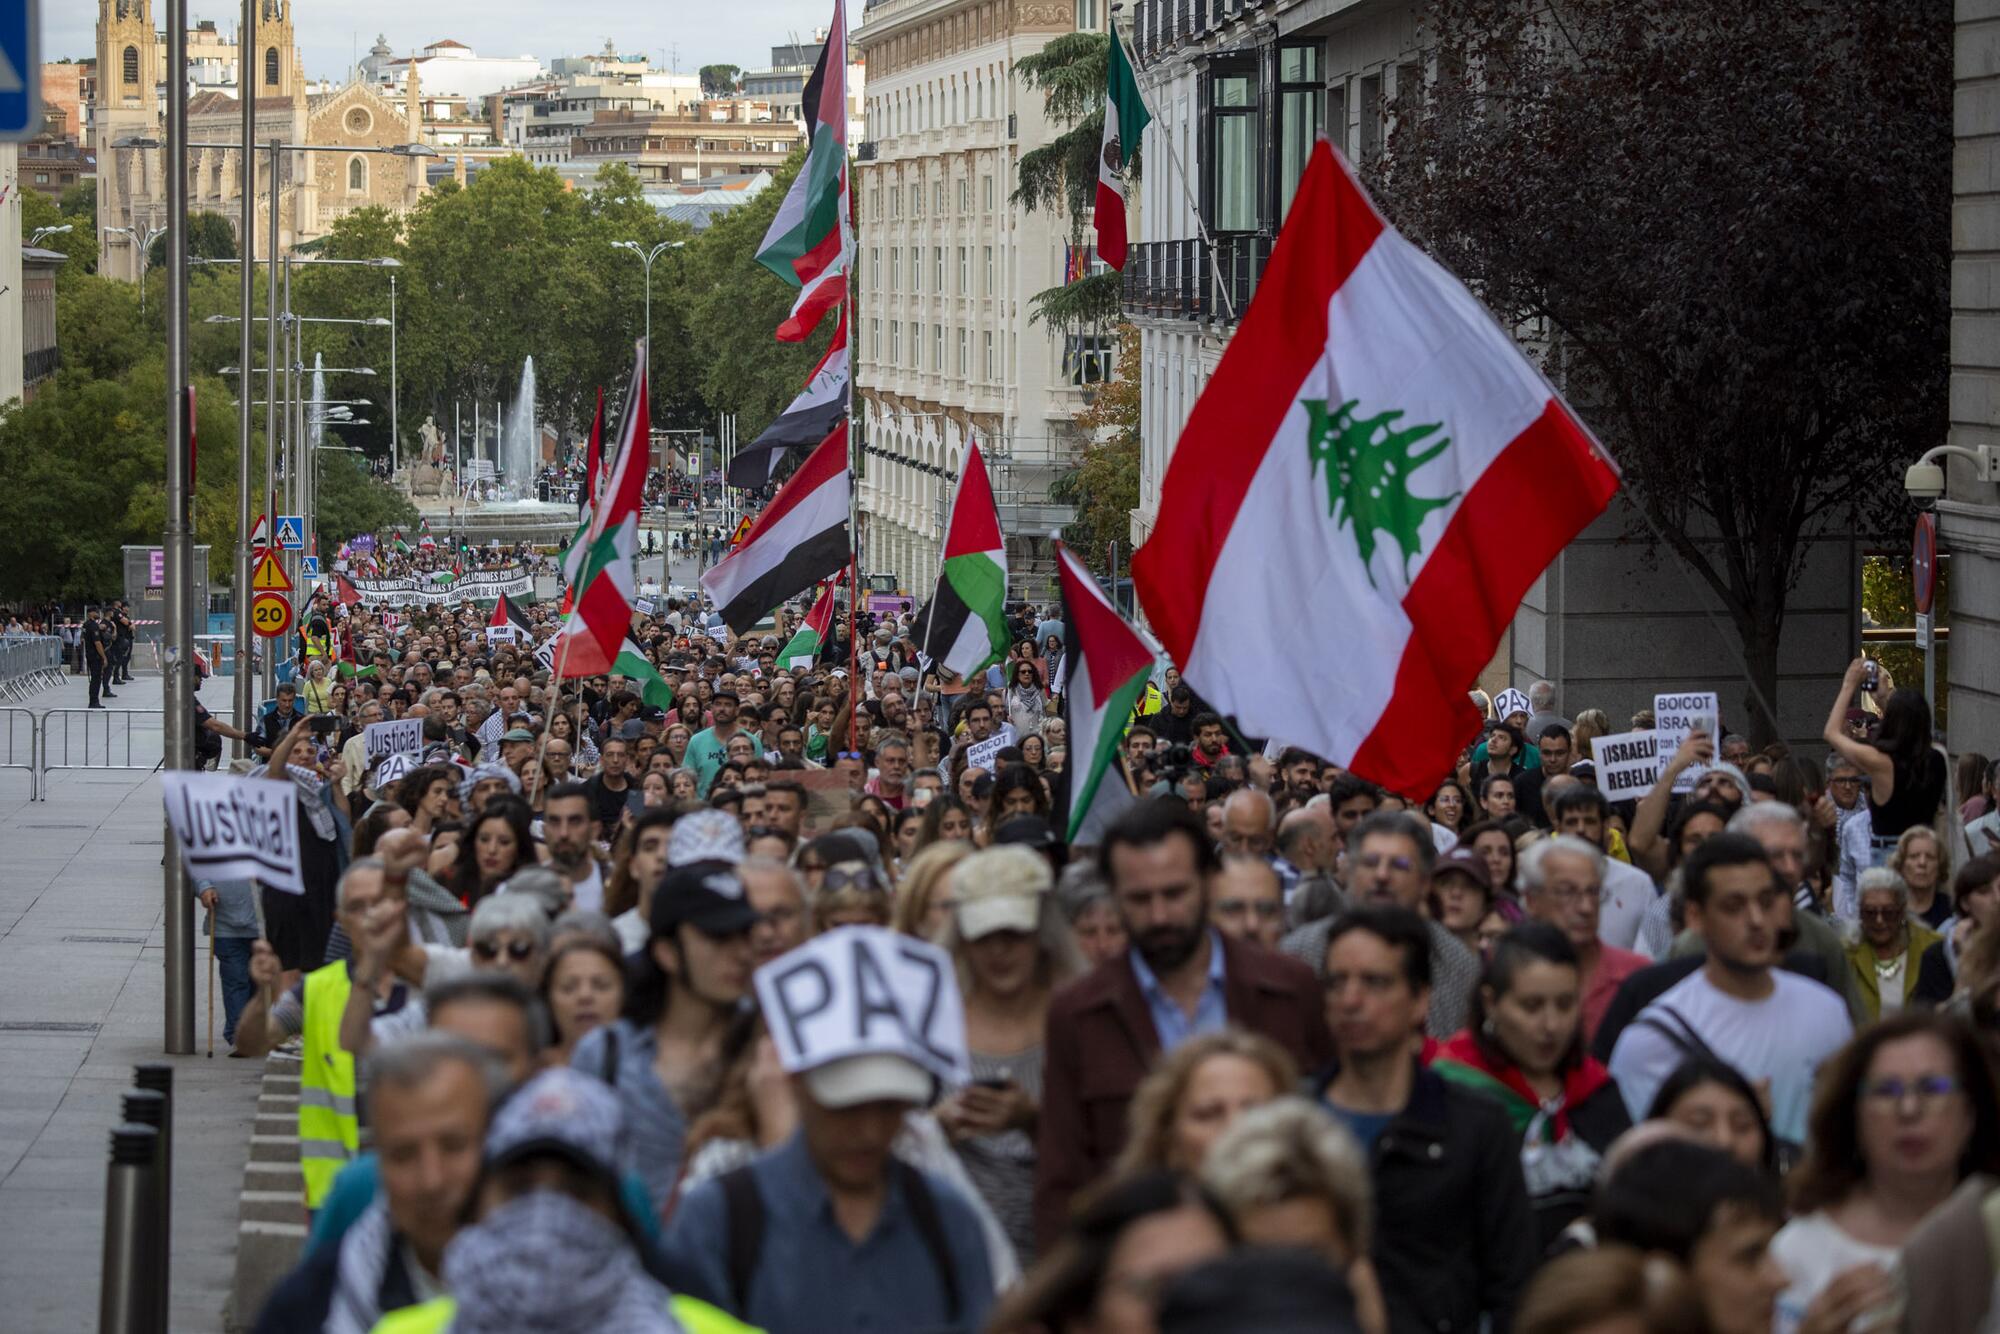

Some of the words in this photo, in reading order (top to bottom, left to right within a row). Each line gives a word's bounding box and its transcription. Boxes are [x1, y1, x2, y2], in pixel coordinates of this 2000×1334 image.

[366, 581, 379, 591] DEL
[500, 570, 512, 581] CON
[482, 586, 490, 596] DE
[256, 608, 283, 623] 20
[383, 613, 399, 629] PAZ
[1496, 690, 1534, 720] PAZ
[1658, 696, 1711, 710] BOICOT
[1659, 716, 1692, 730] ISRA
[368, 723, 420, 756] Justicia!
[970, 735, 1007, 756] BOICOT
[970, 751, 998, 768] ISRAE
[179, 784, 293, 858] Justicia!
[773, 940, 956, 1067] PAZ
